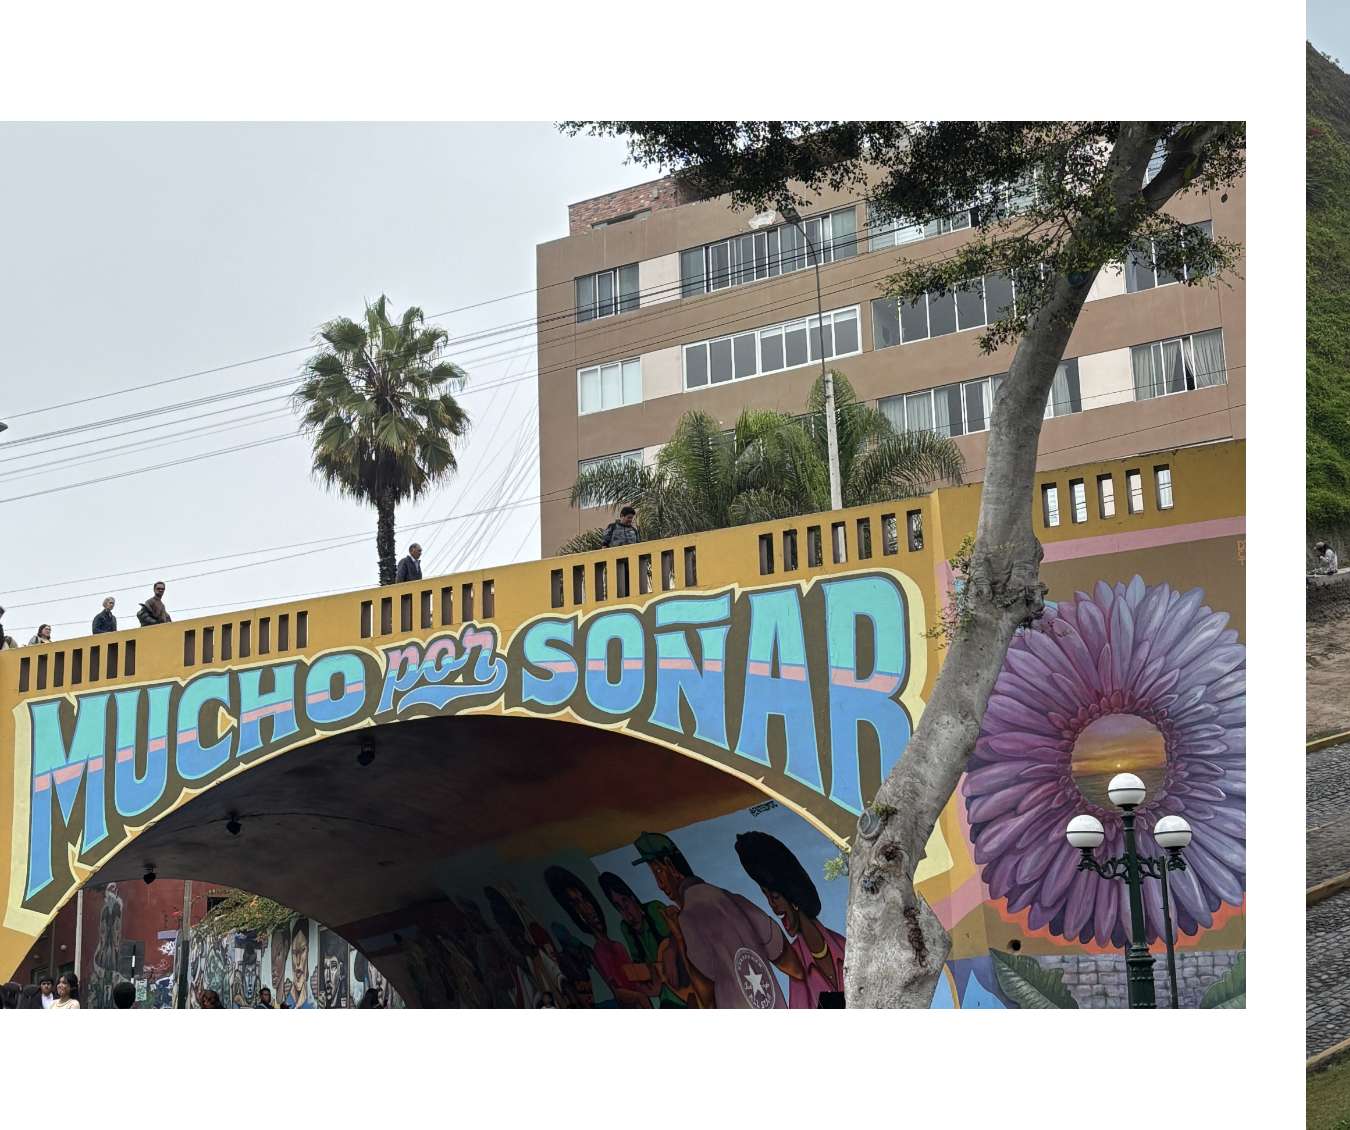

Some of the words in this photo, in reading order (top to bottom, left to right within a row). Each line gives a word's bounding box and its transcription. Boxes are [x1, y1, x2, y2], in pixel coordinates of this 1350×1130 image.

[26, 653, 366, 901] MUCHO
[374, 627, 508, 715] por
[522, 574, 912, 816] SOÑAR
